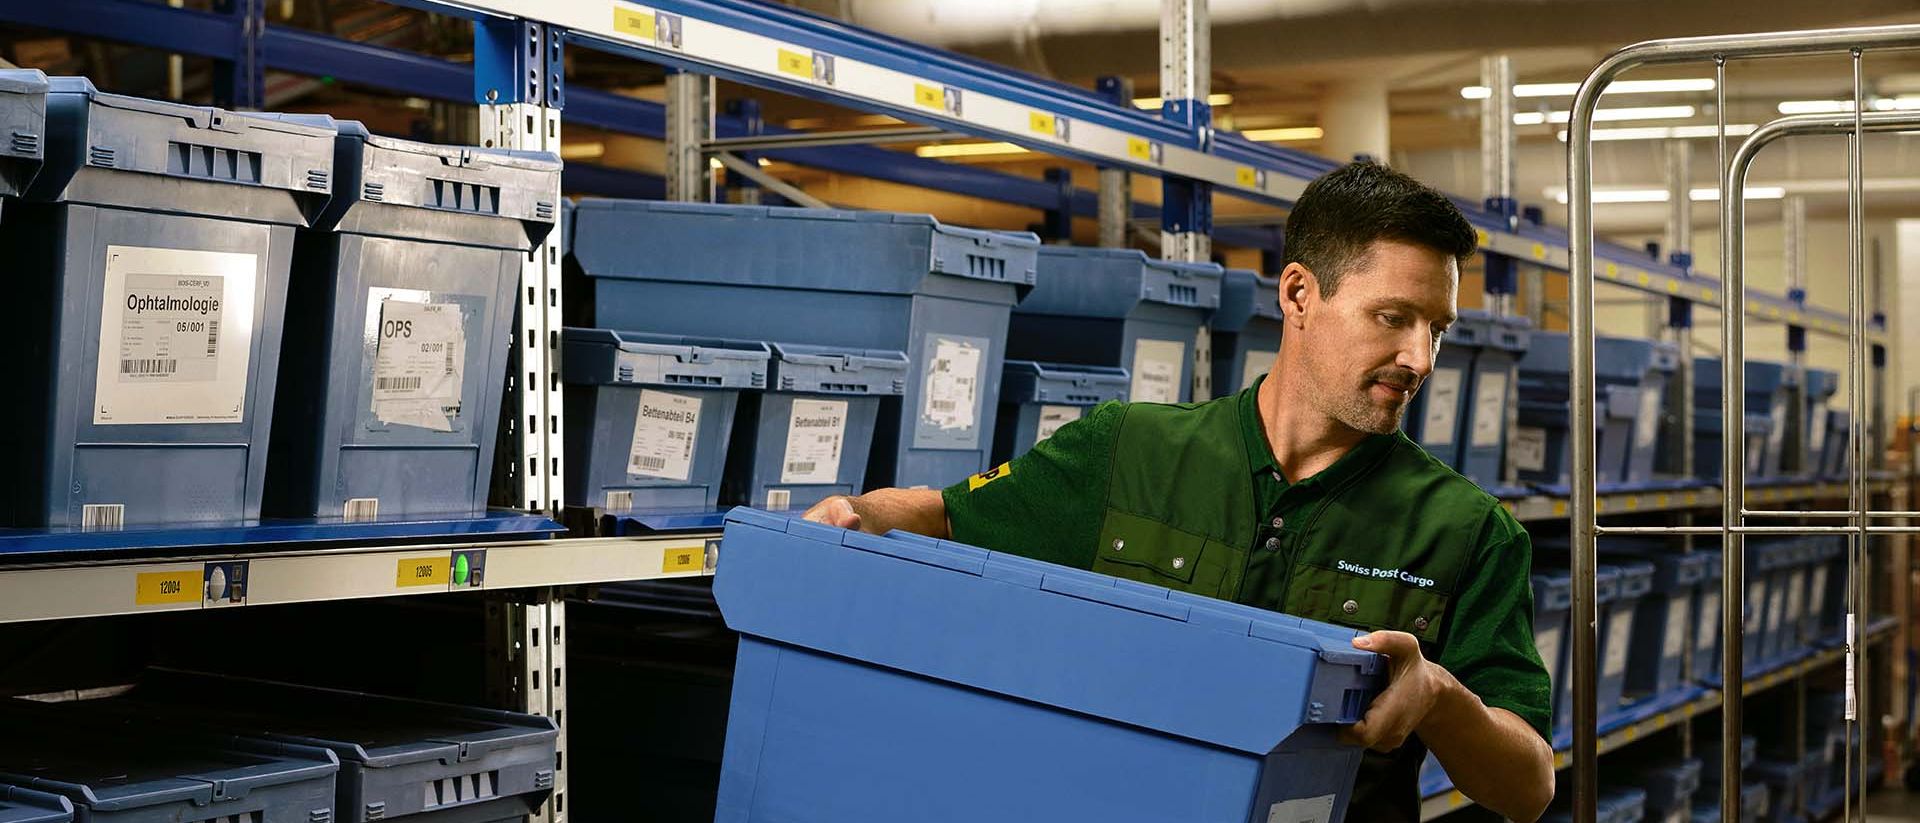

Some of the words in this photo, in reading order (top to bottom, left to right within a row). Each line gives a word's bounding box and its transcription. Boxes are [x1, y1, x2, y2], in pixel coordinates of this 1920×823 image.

[127, 294, 219, 315] Ophtalmologie
[176, 321, 205, 332] 05/001
[384, 320, 412, 338] OPS
[421, 342, 443, 353] 02/001
[642, 404, 684, 422] Bettenabteil
[685, 411, 696, 424] B4
[415, 565, 432, 578] 12005
[1337, 560, 1370, 575] Swiss
[1371, 568, 1399, 579] Post
[1400, 571, 1434, 587] Cargo
[160, 580, 180, 594] 12004
